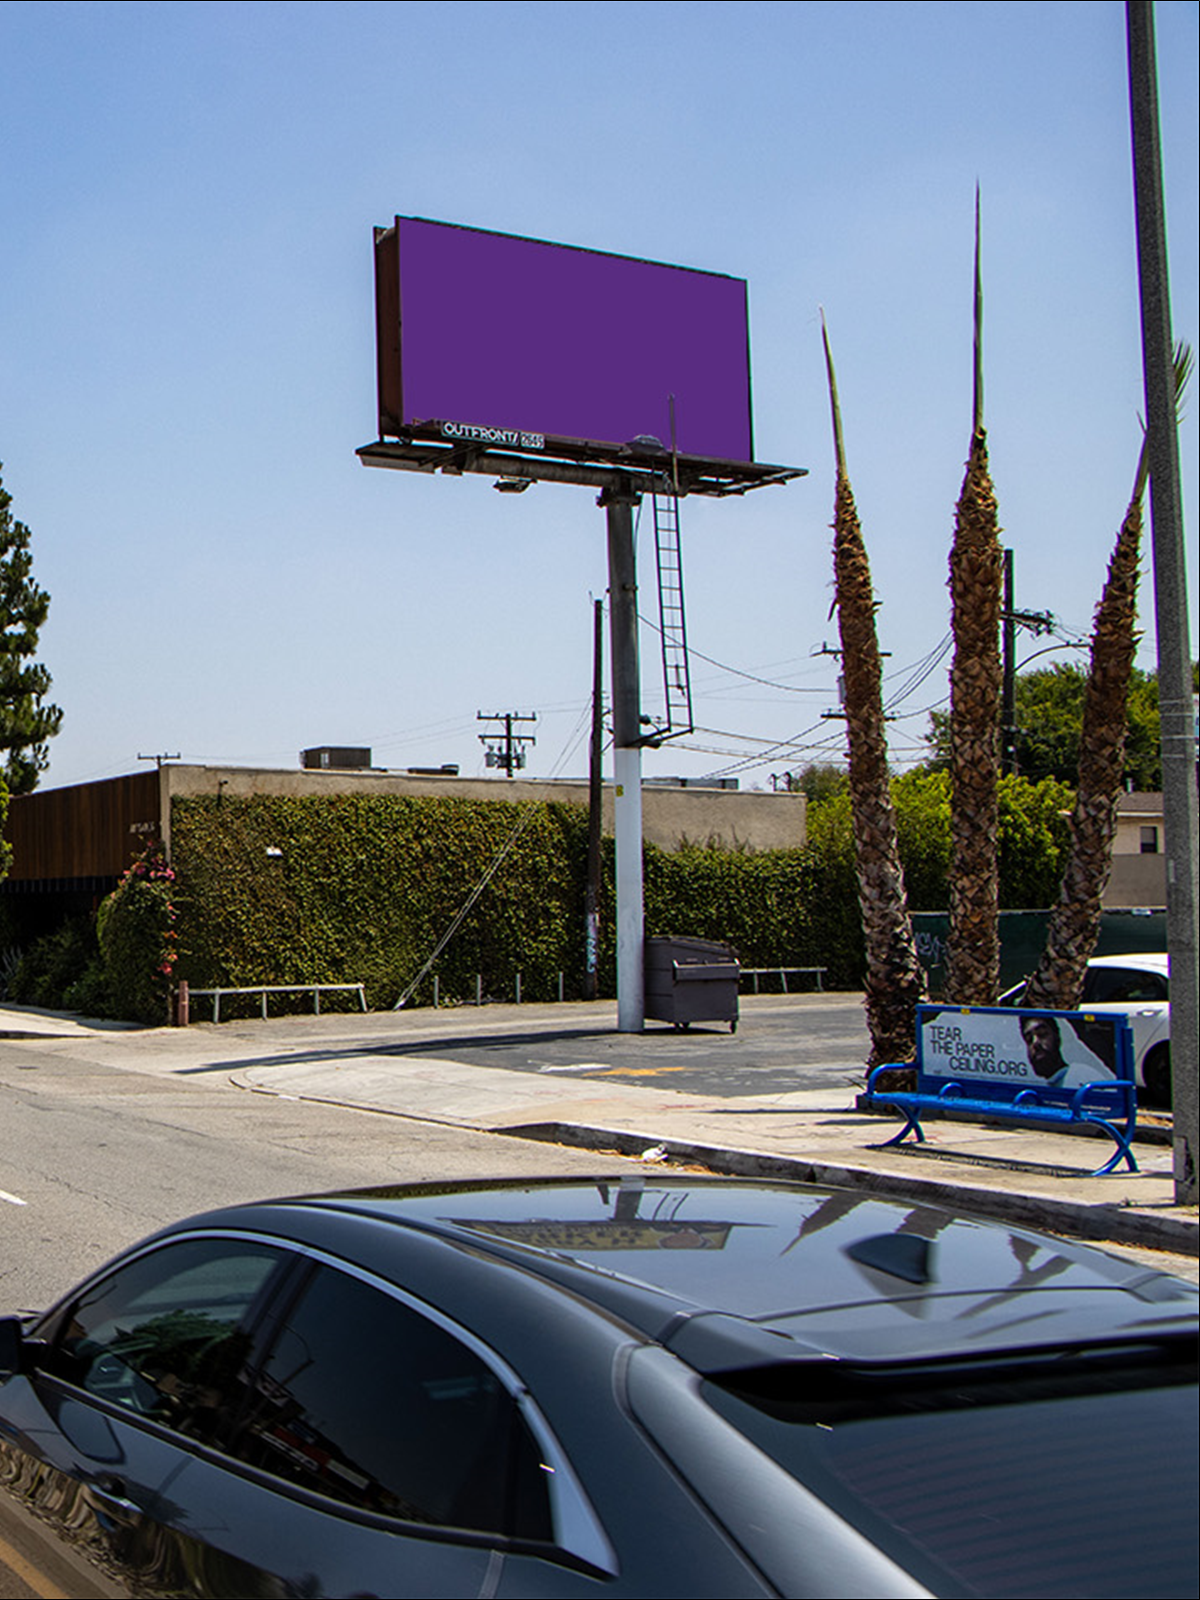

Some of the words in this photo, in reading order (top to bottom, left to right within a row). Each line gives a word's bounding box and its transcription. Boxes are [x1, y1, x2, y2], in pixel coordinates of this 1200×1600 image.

[929, 1025, 962, 1041] TEAR
[930, 1040, 954, 1056] THE
[955, 1042, 995, 1058] PAPER
[949, 1056, 1028, 1077] CEILING.ORG
